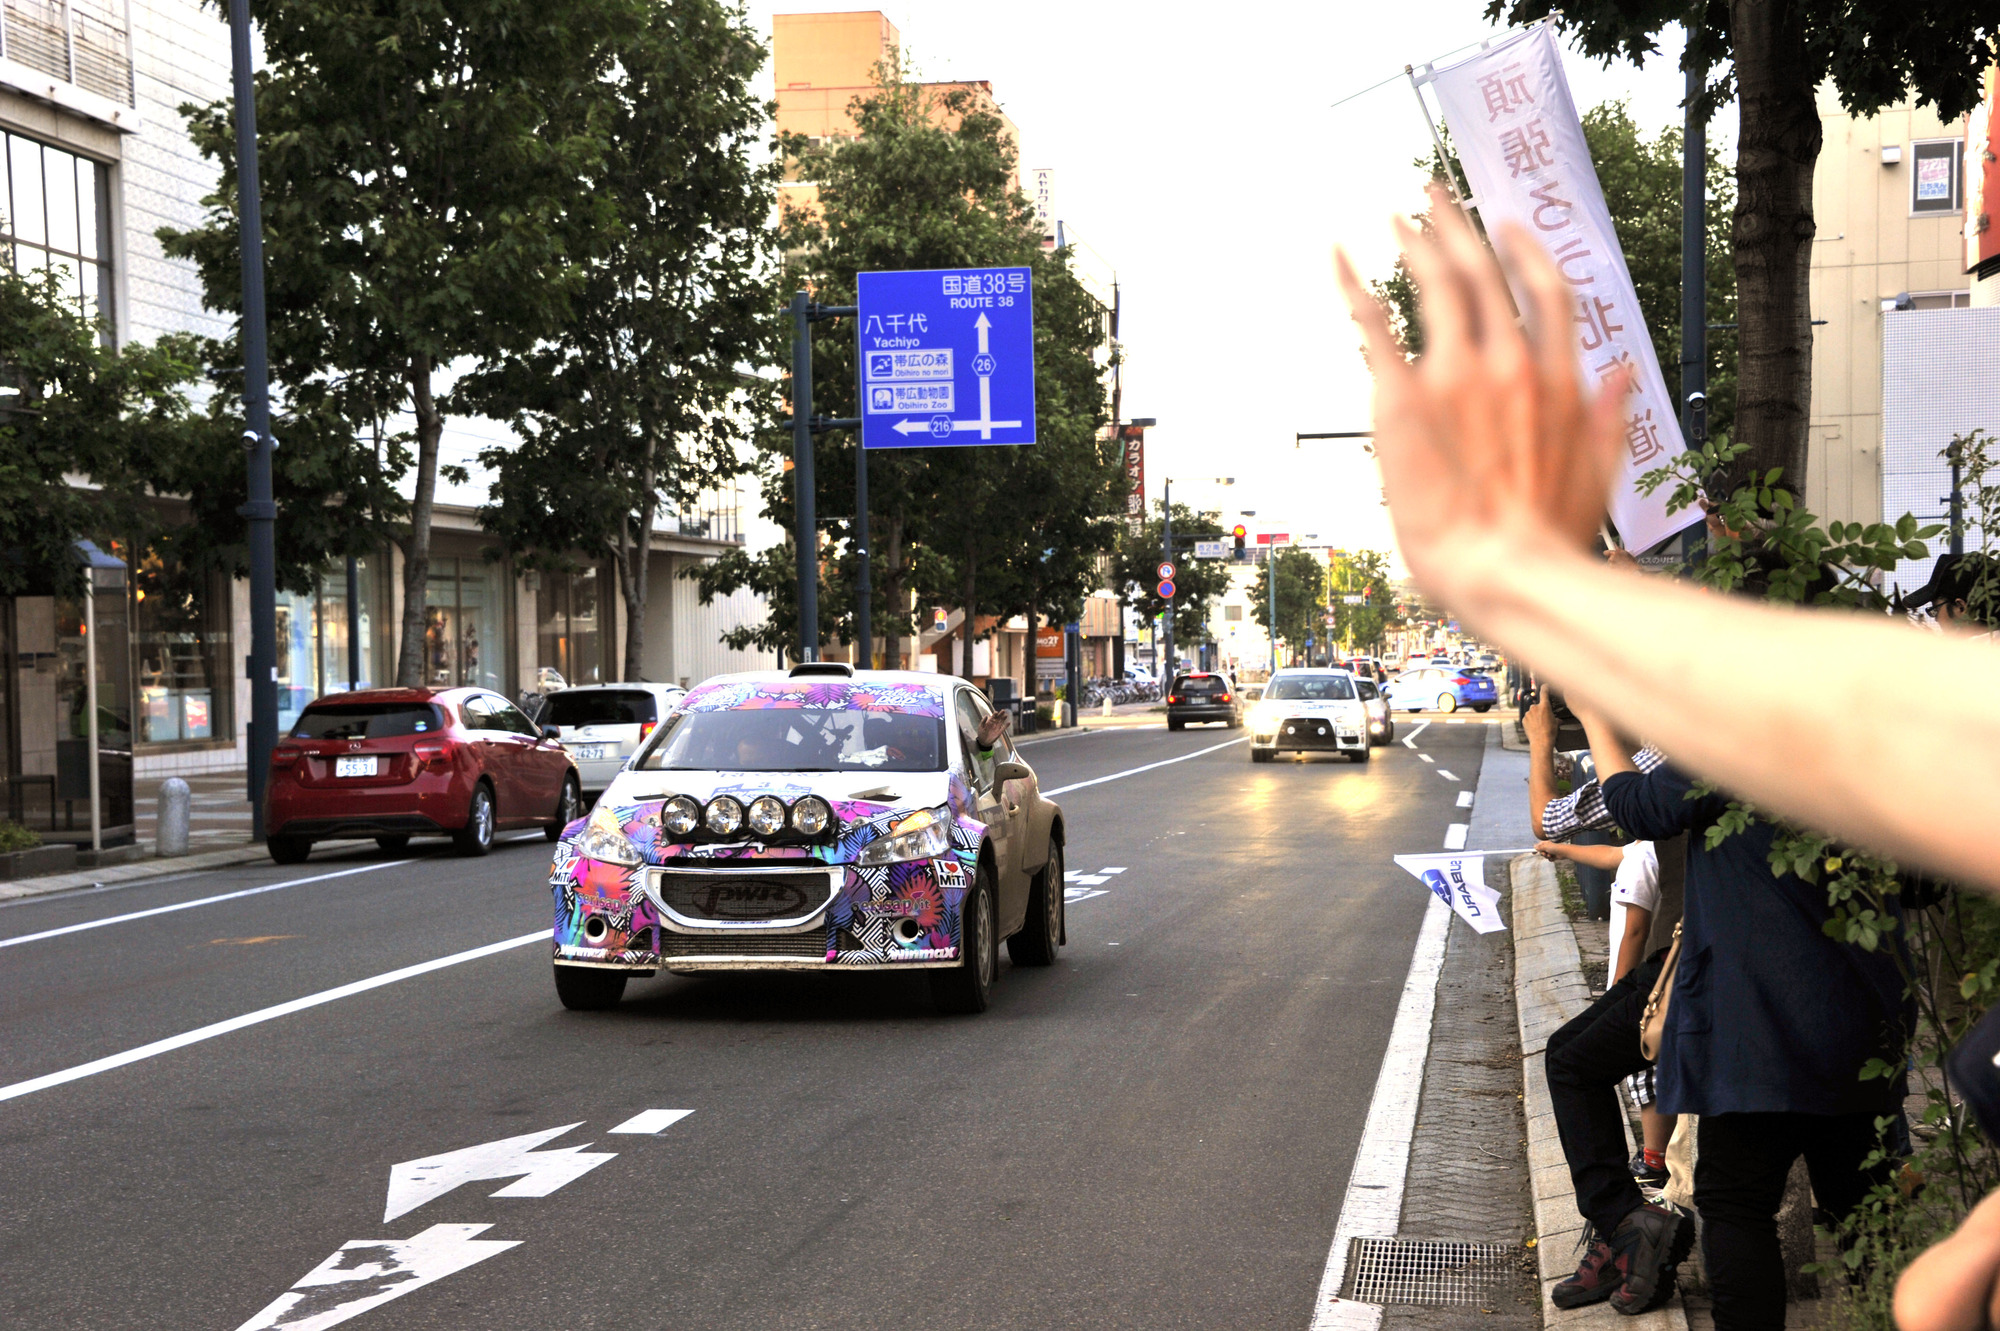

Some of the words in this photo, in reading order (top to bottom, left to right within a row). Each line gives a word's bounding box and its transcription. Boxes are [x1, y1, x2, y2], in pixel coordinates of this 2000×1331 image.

[942, 273, 1026, 295] 国道38号
[950, 297, 993, 309] ROUTE
[997, 296, 1014, 307] 38
[865, 313, 928, 335] 八千代
[873, 337, 920, 350] Yachiyo
[894, 353, 949, 367] 帯広の森
[976, 359, 991, 371] 26
[895, 369, 921, 377] Obihiro
[895, 386, 950, 400] 帯広動物園
[898, 401, 928, 409] Obihiro
[931, 401, 948, 409] Zoo
[933, 421, 950, 432] 216
[345, 763, 374, 774] 55-31
[940, 874, 965, 886] MiTi
